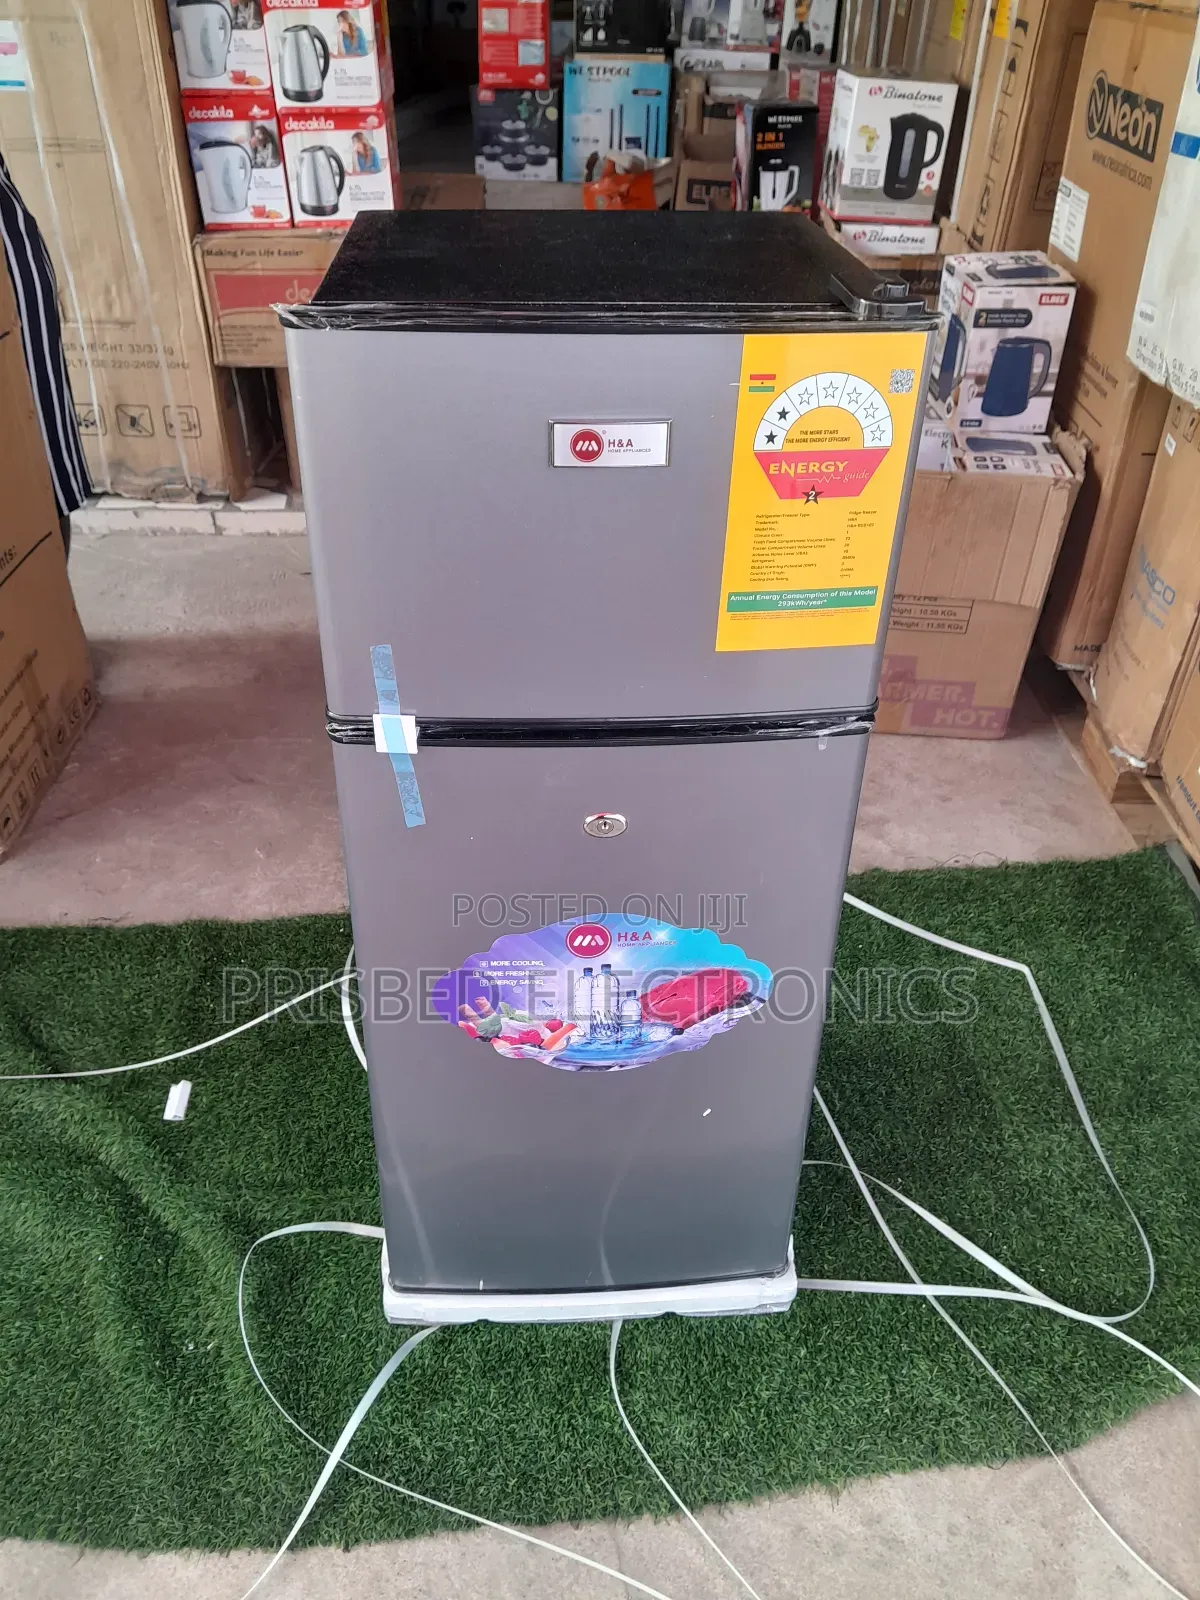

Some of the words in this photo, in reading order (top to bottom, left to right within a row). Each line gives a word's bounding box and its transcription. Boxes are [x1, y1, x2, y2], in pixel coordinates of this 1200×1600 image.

[883, 85, 943, 102] Binatone
[188, 104, 234, 119] decakila
[284, 115, 335, 131] decakila
[1103, 91, 1157, 155] Neon
[867, 230, 926, 244] Binatone
[206, 249, 238, 258] Making
[259, 249, 274, 258] Life
[607, 438, 634, 448] H&A
[769, 460, 849, 478] ENERGY
[843, 468, 870, 483] guide
[808, 490, 816, 500] 2
[782, 592, 829, 600] Consumption
[892, 620, 919, 628] Weight
[932, 707, 1000, 728] HOT.
[617, 931, 652, 942] H&A
